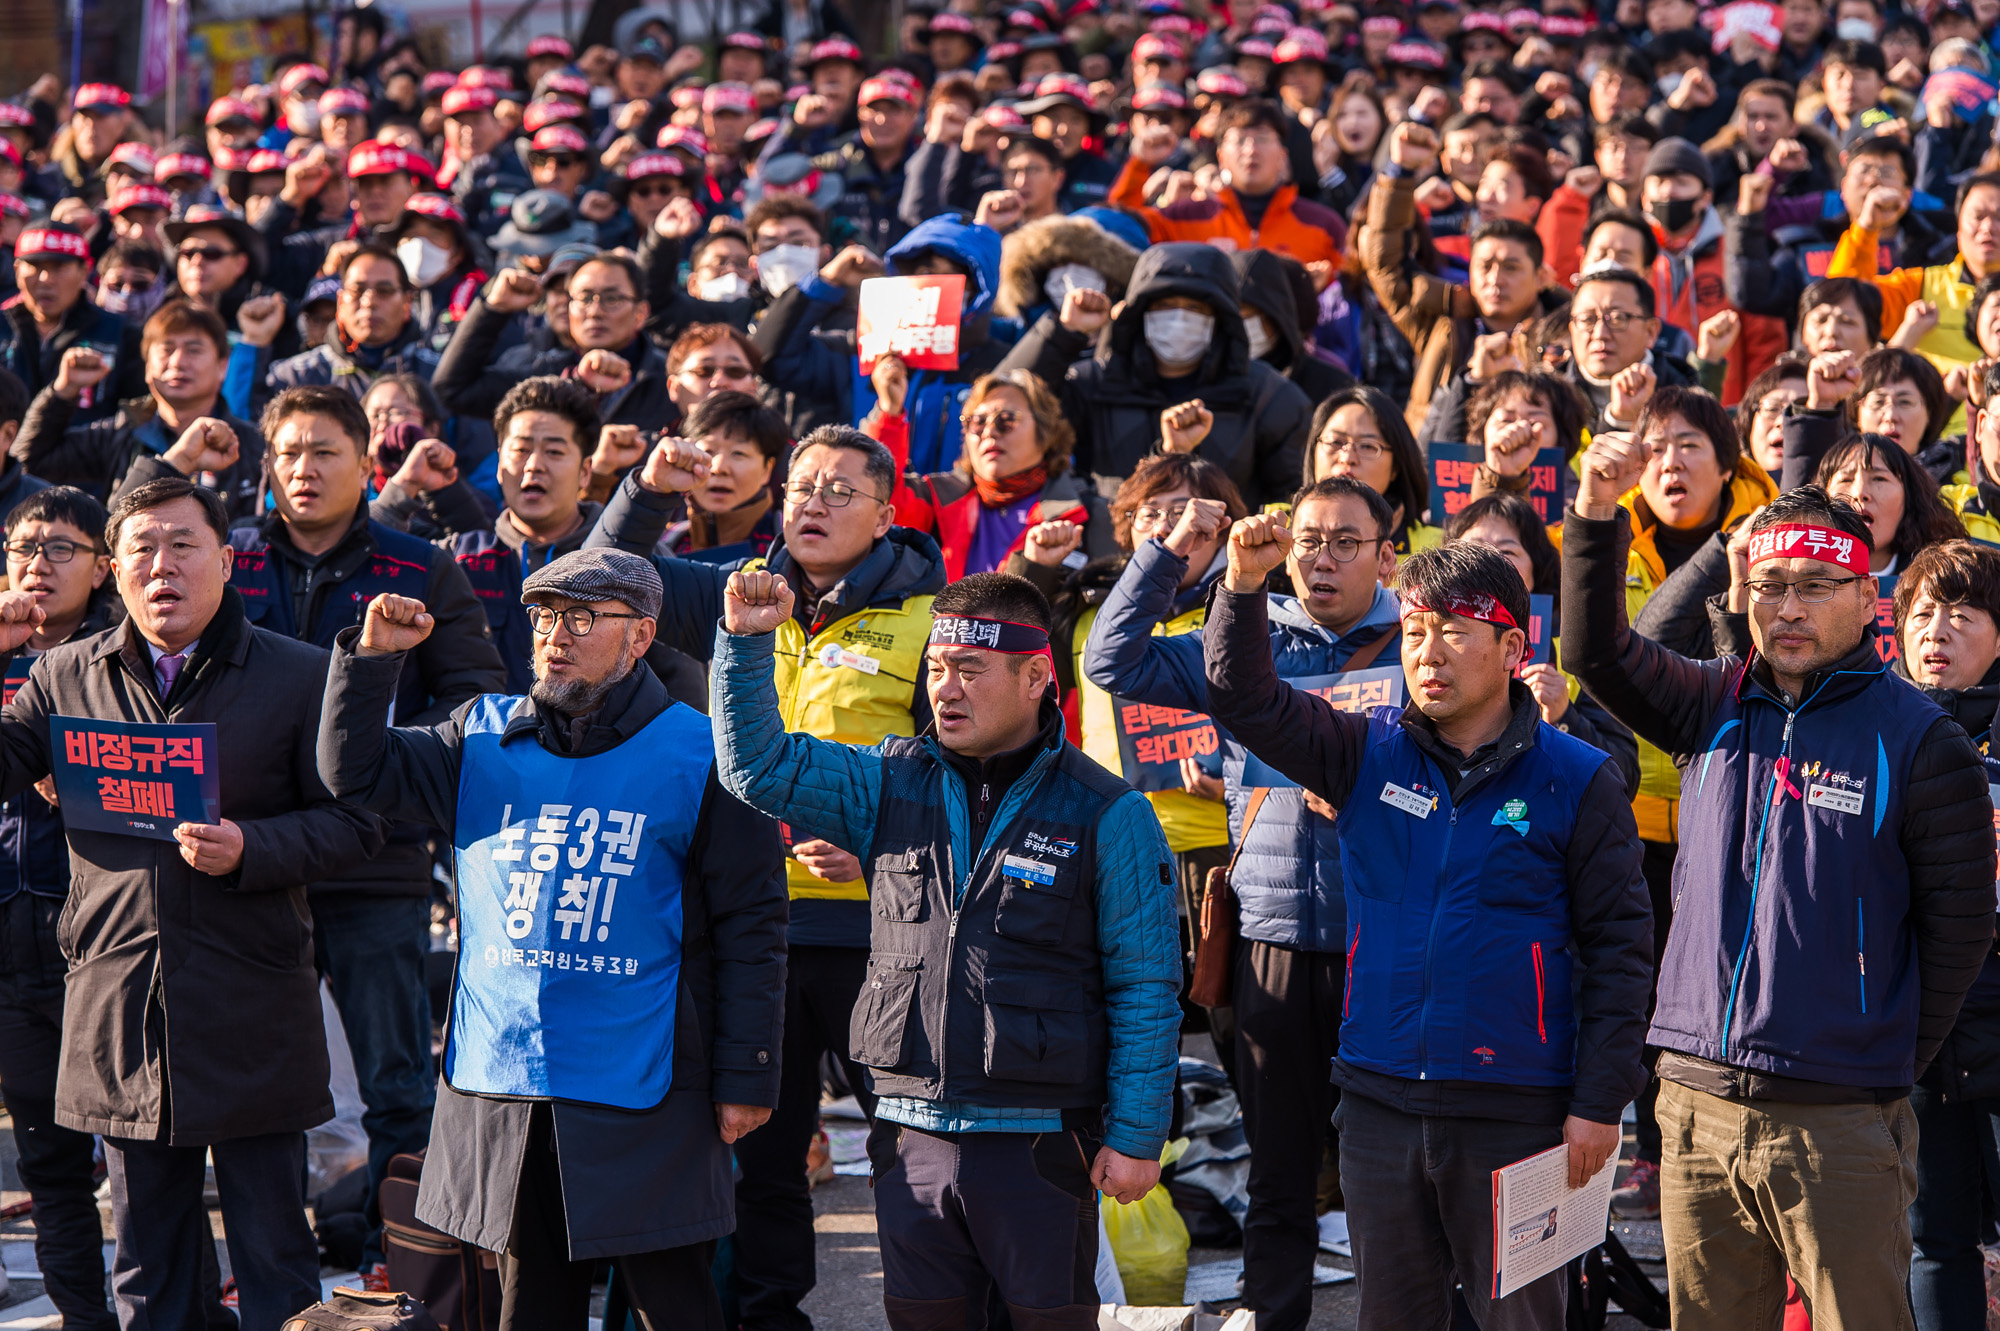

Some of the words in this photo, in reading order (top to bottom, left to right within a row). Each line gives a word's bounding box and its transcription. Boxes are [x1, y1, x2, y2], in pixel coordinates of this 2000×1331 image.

[1803, 529, 1854, 564] 투쟁
[64, 730, 204, 775] 비정규직
[97, 776, 176, 818] 철폐!
[491, 803, 647, 877] 노동3권
[1023, 838, 1070, 858] 공공운수노조
